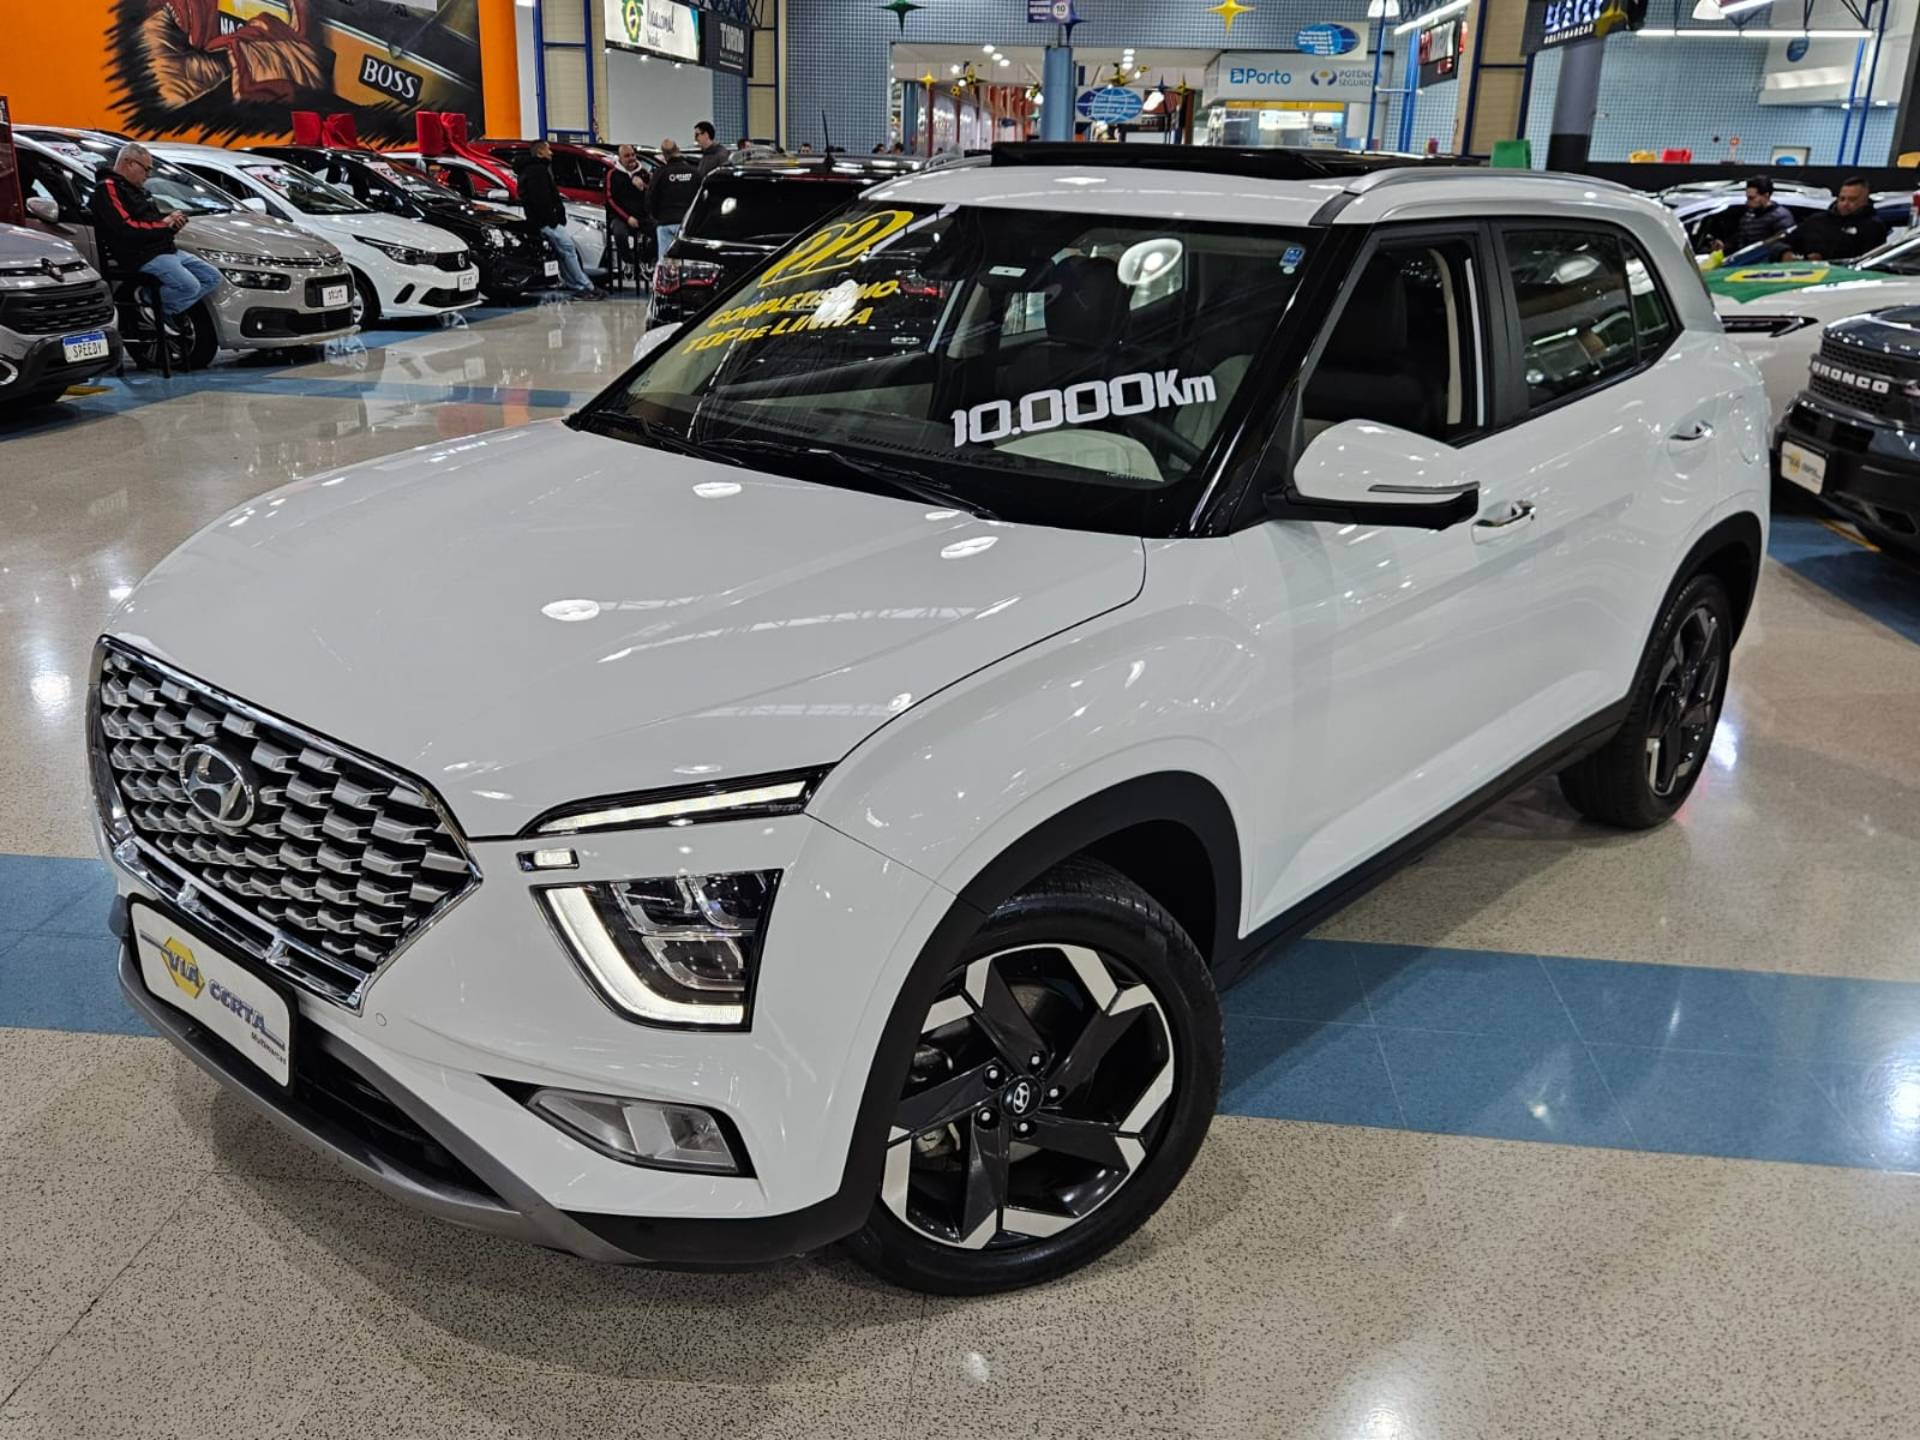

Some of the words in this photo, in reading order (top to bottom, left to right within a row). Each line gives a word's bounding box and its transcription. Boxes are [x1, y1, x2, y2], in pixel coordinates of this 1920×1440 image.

[362, 57, 418, 98] BOSS
[1246, 68, 1292, 85] Porto
[1338, 69, 1383, 78] POTENC
[757, 209, 914, 288] 22
[682, 327, 745, 355] TOP
[1811, 360, 1890, 395] BRONCO
[951, 368, 1218, 448] 10.000Km
[167, 950, 201, 987] VIA
[208, 979, 266, 1033] CERTA
